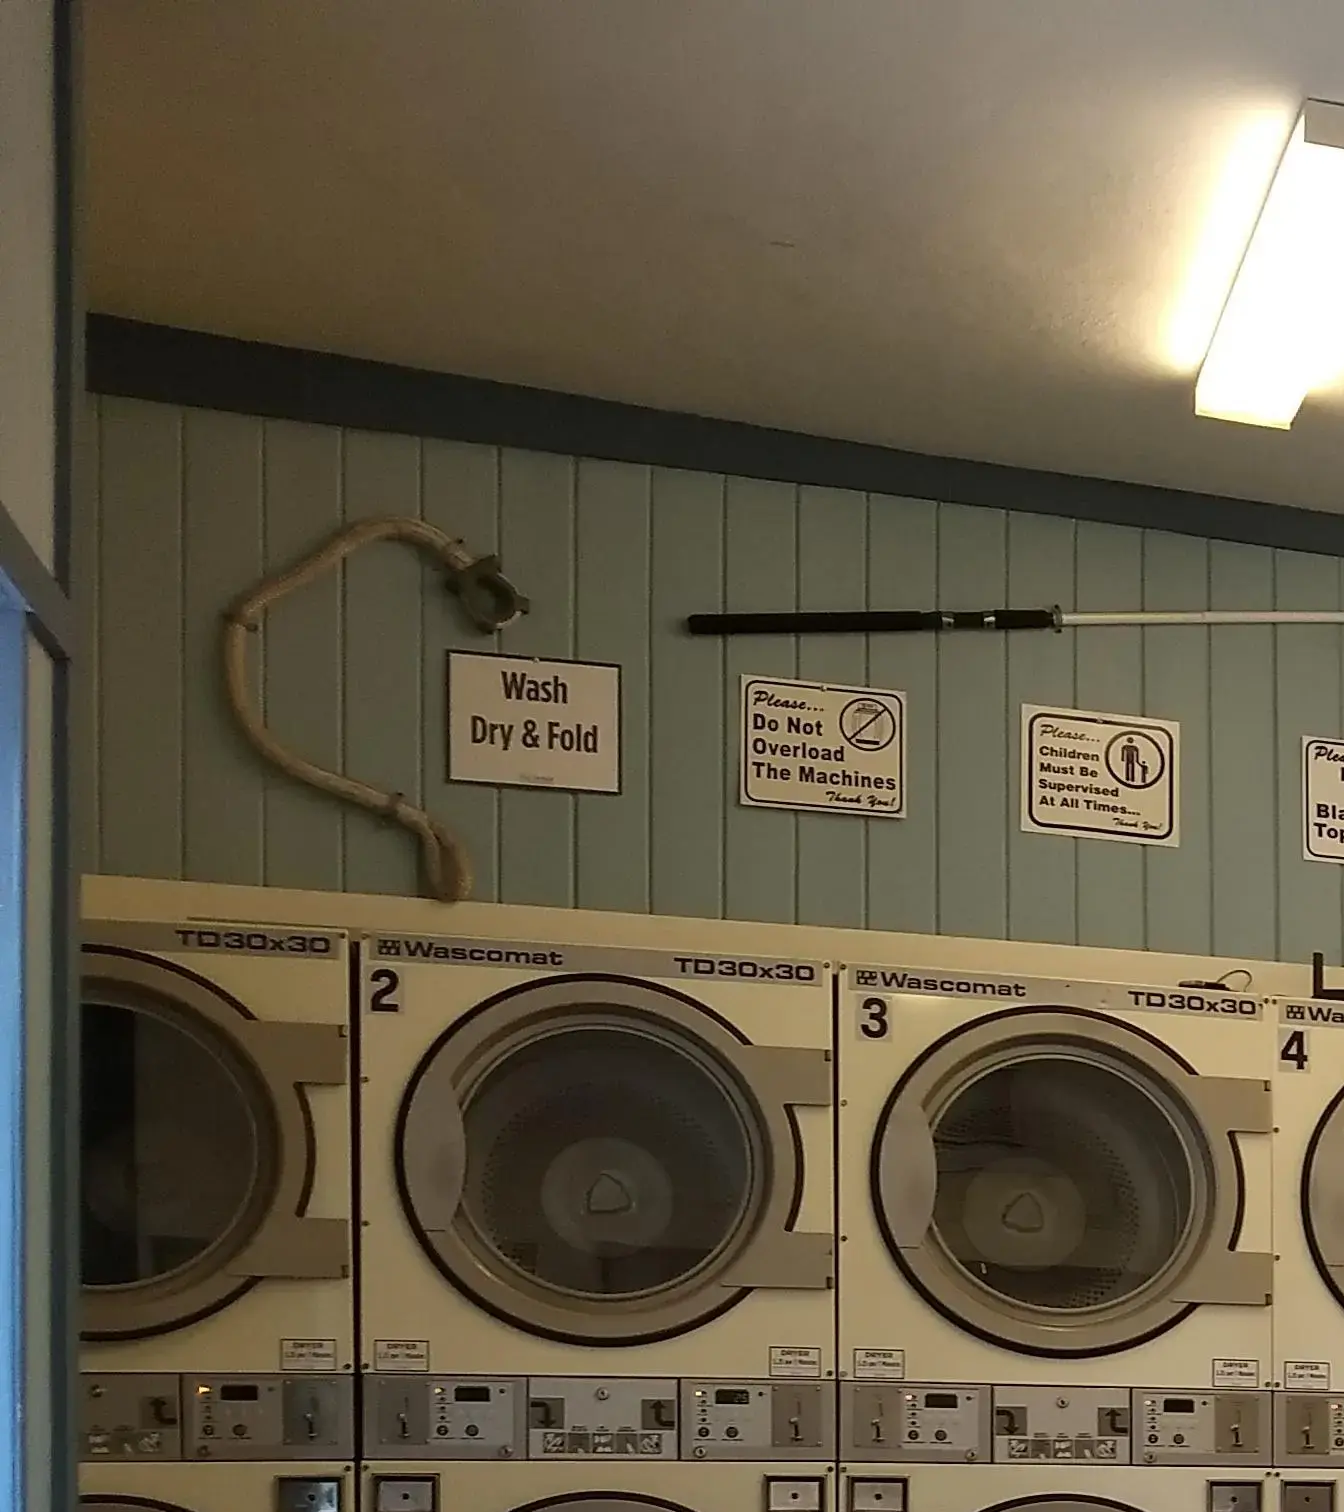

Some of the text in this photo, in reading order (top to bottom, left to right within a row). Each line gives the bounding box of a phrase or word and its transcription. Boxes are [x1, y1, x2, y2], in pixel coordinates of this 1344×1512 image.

[501, 671, 568, 703] Wash
[753, 690, 824, 712] Please...
[471, 715, 598, 753] Dry & Fold
[753, 713, 823, 736] Do Not
[1040, 724, 1100, 742] Please...
[753, 738, 845, 762] Overload
[1039, 746, 1099, 761] Children
[752, 761, 896, 790] The Machines
[1040, 762, 1098, 778] Must Be
[825, 791, 896, 807] Thank You!
[1039, 778, 1119, 797] Supervised
[1039, 796, 1141, 815] At All Times...
[1112, 818, 1138, 828] Thank
[174, 929, 331, 953] TD30x30
[404, 940, 564, 966] Wascomat
[674, 956, 815, 981] TD30x30
[370, 968, 399, 1012] 2
[880, 971, 1027, 998] Wascomat
[1128, 990, 1257, 1016] TD30x30
[860, 997, 888, 1039] 3
[1280, 1030, 1308, 1070] 4
